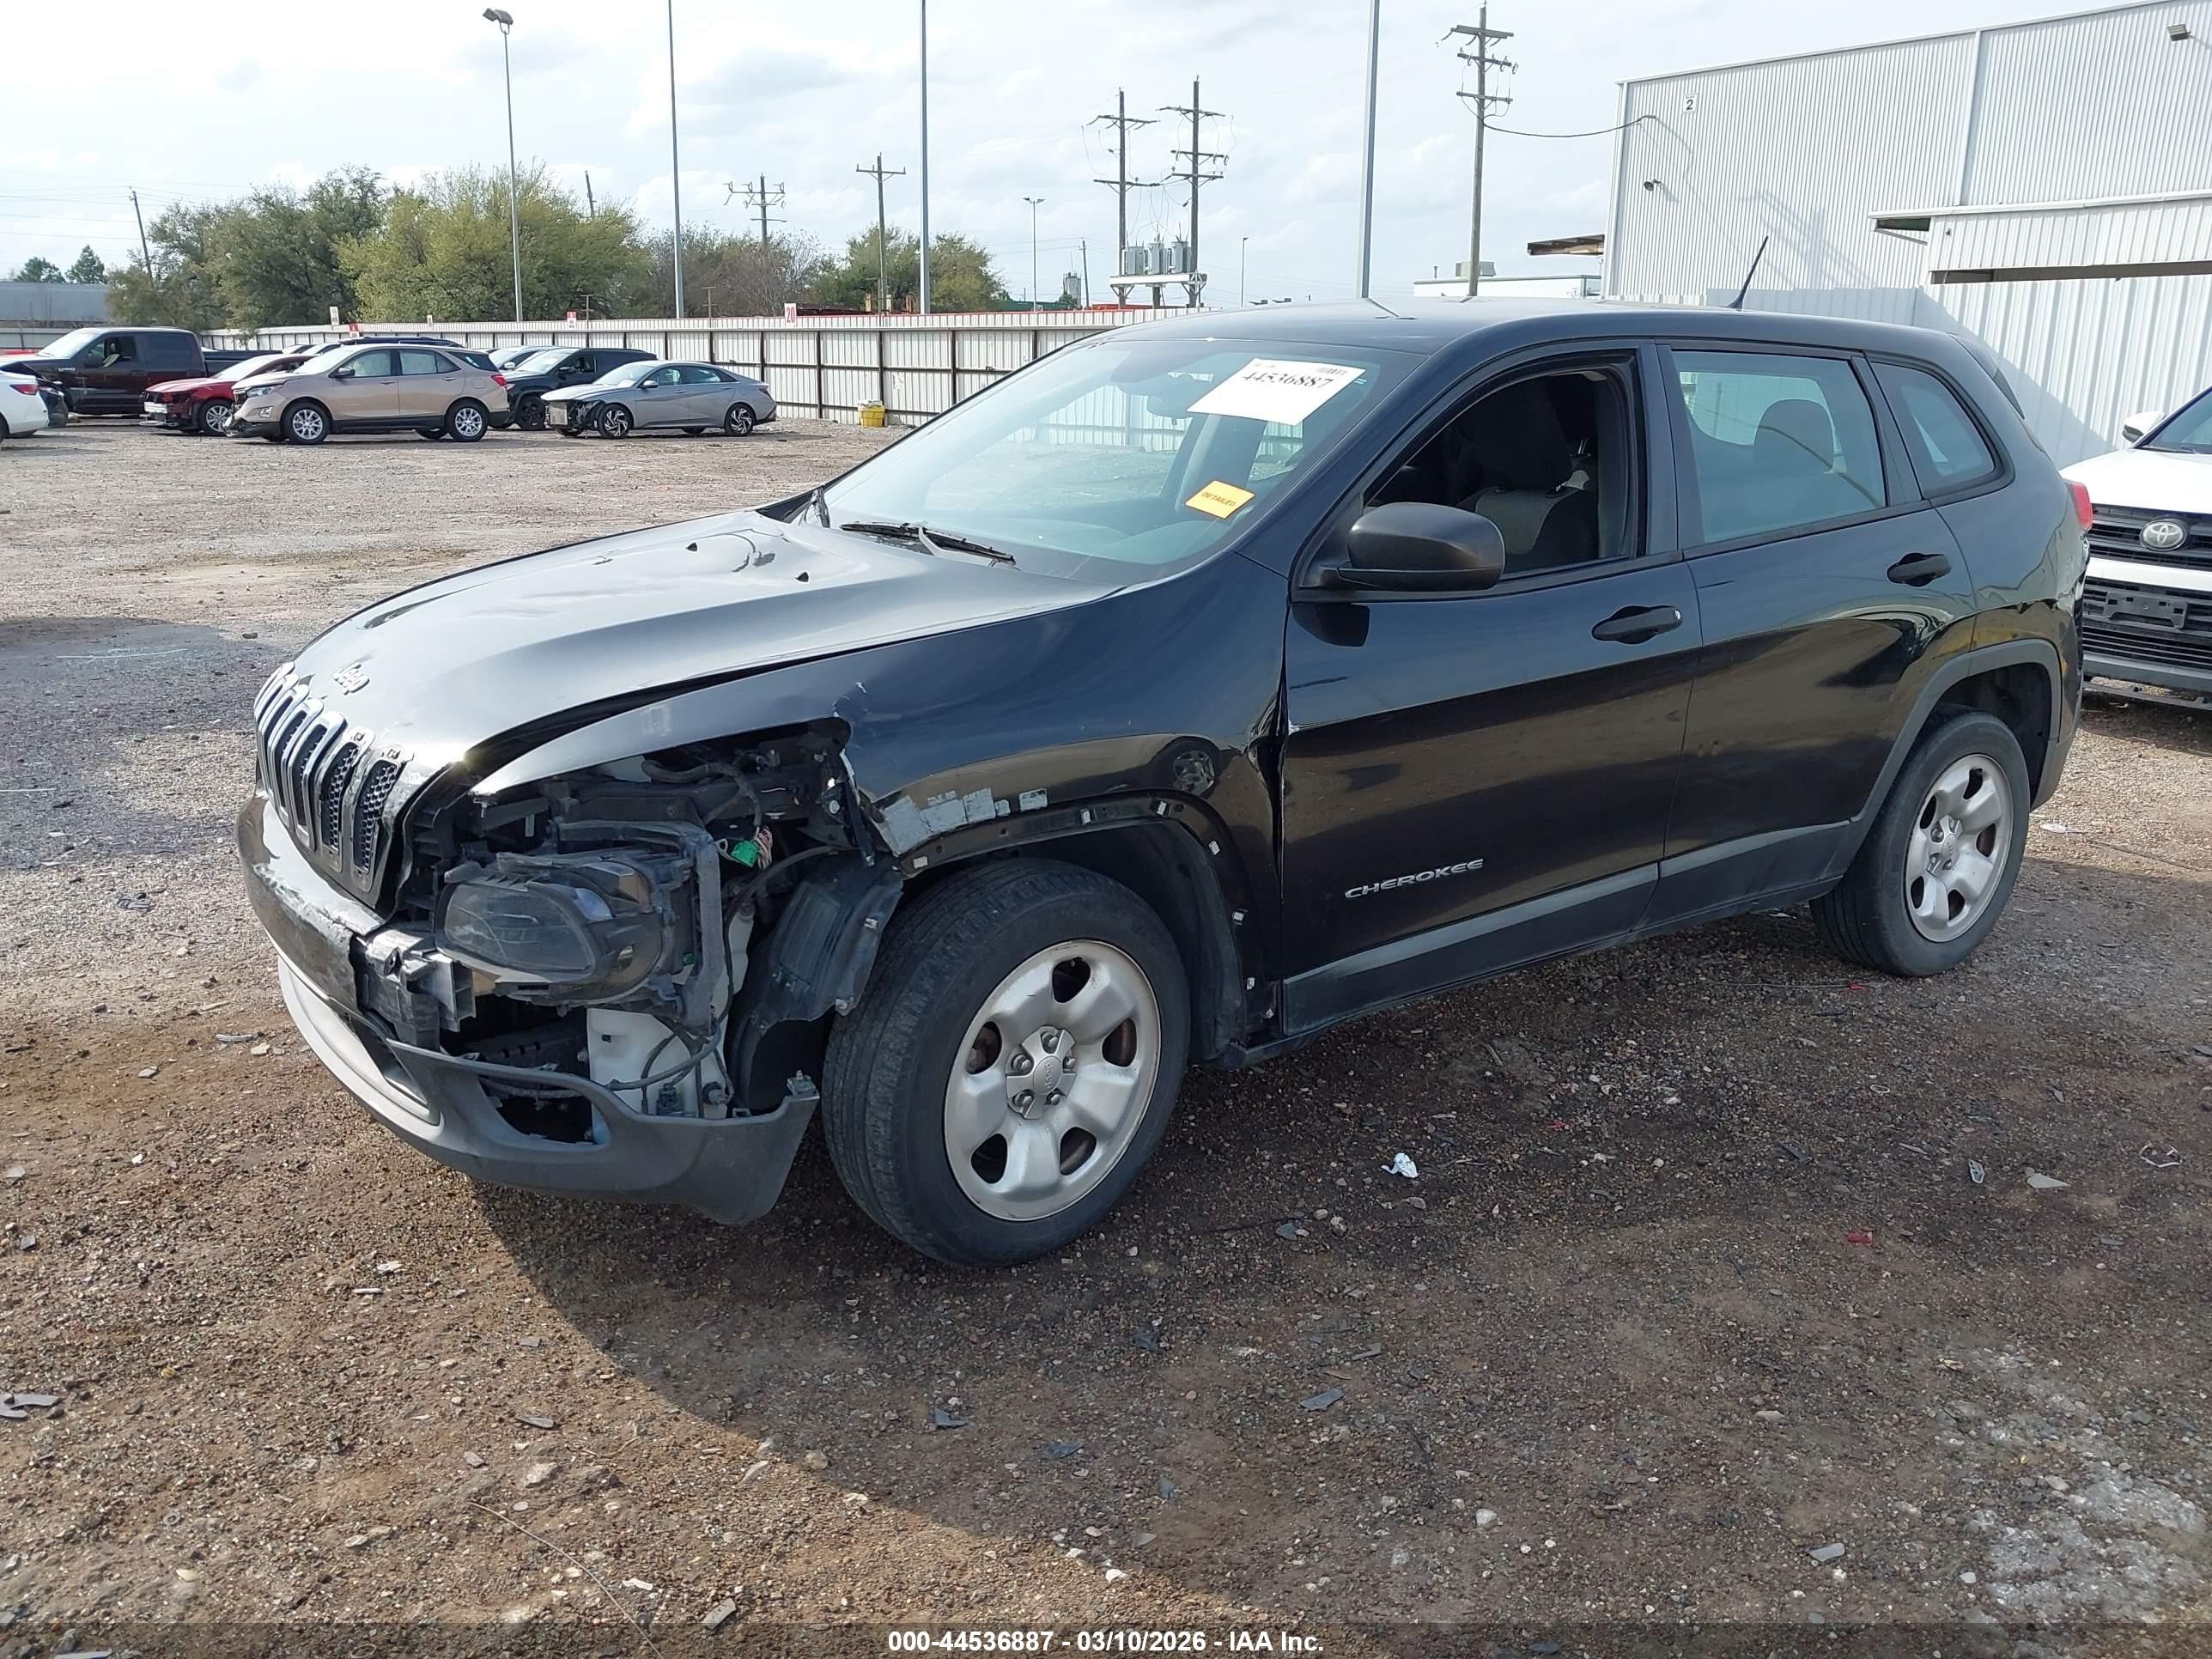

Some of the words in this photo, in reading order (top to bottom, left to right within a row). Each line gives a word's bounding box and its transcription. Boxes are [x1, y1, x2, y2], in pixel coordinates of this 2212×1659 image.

[1686, 99, 1693, 111] 2
[787, 307, 795, 323] 20
[1243, 372, 1334, 389] 44536887
[1201, 490, 1237, 507] DETAILED
[1345, 859, 1484, 899] CHEROKEE
